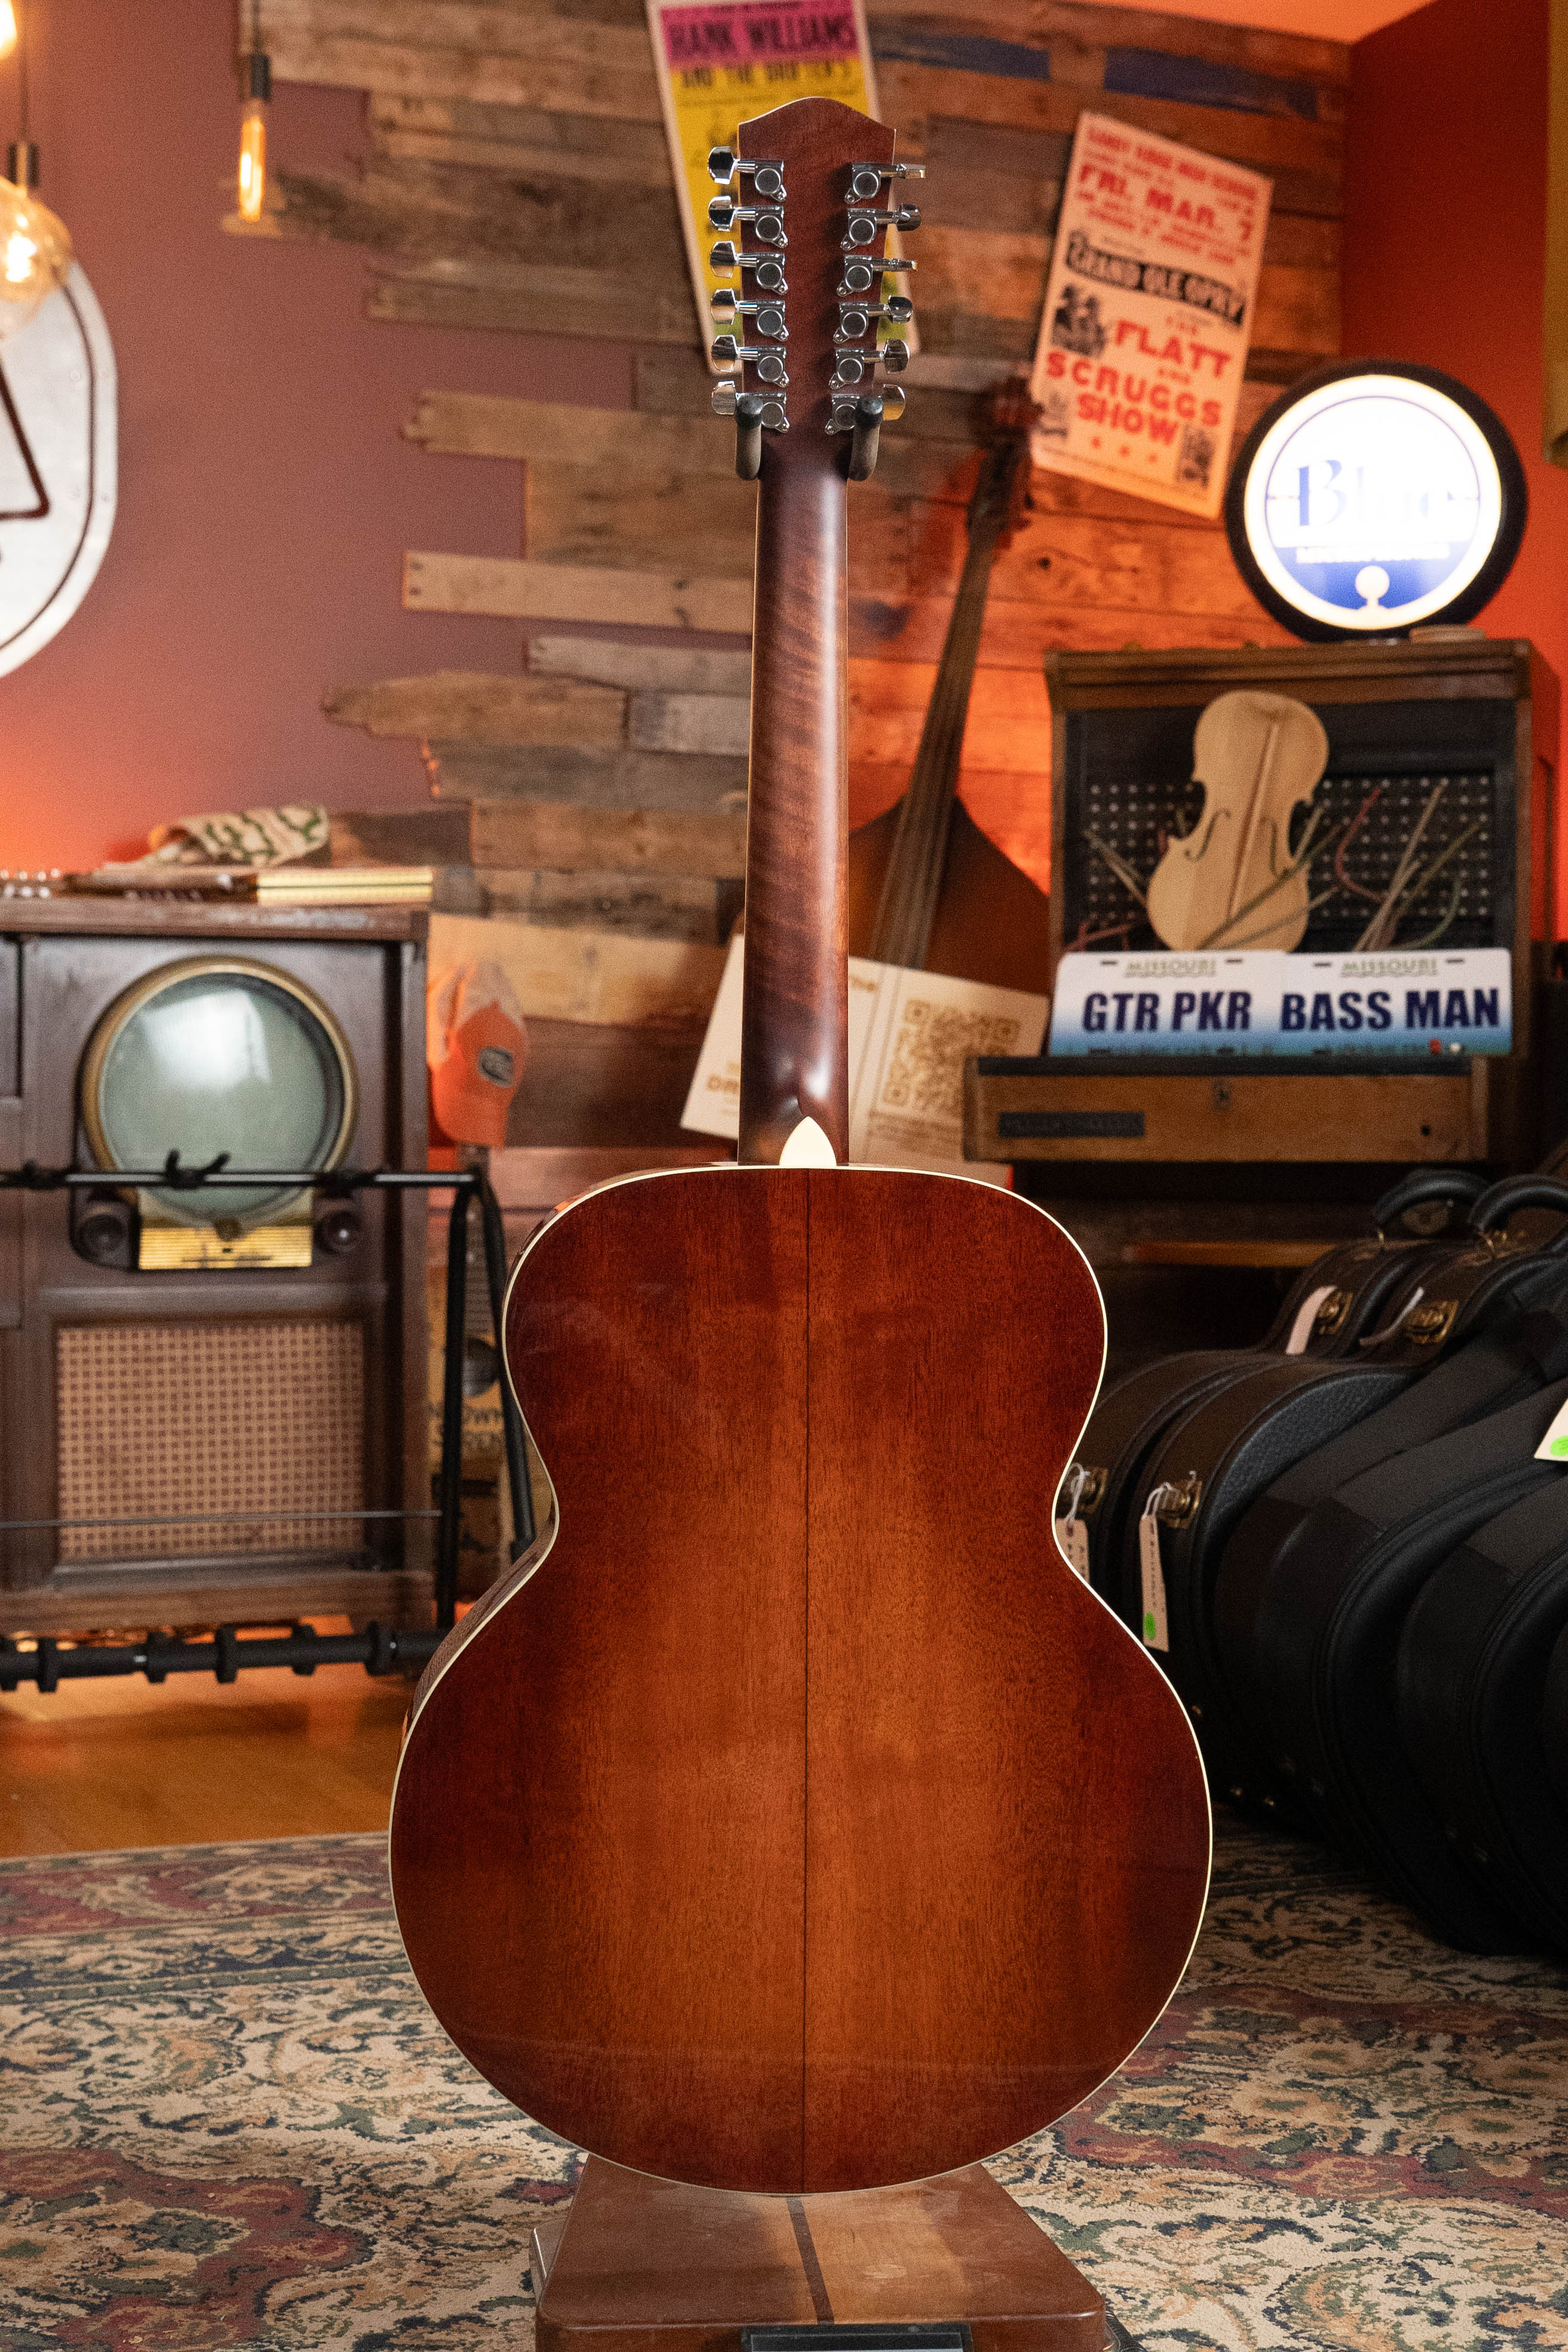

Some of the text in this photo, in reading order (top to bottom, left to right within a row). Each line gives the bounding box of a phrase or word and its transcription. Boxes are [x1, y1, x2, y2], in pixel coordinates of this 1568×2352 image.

[1115, 318, 1232, 378] FLATT
[1046, 351, 1223, 427] SCRUGGS
[1077, 392, 1179, 446] SHOW
[1081, 991, 1252, 1032] GTR PKR
[1279, 987, 1500, 1032] BASS MAN
